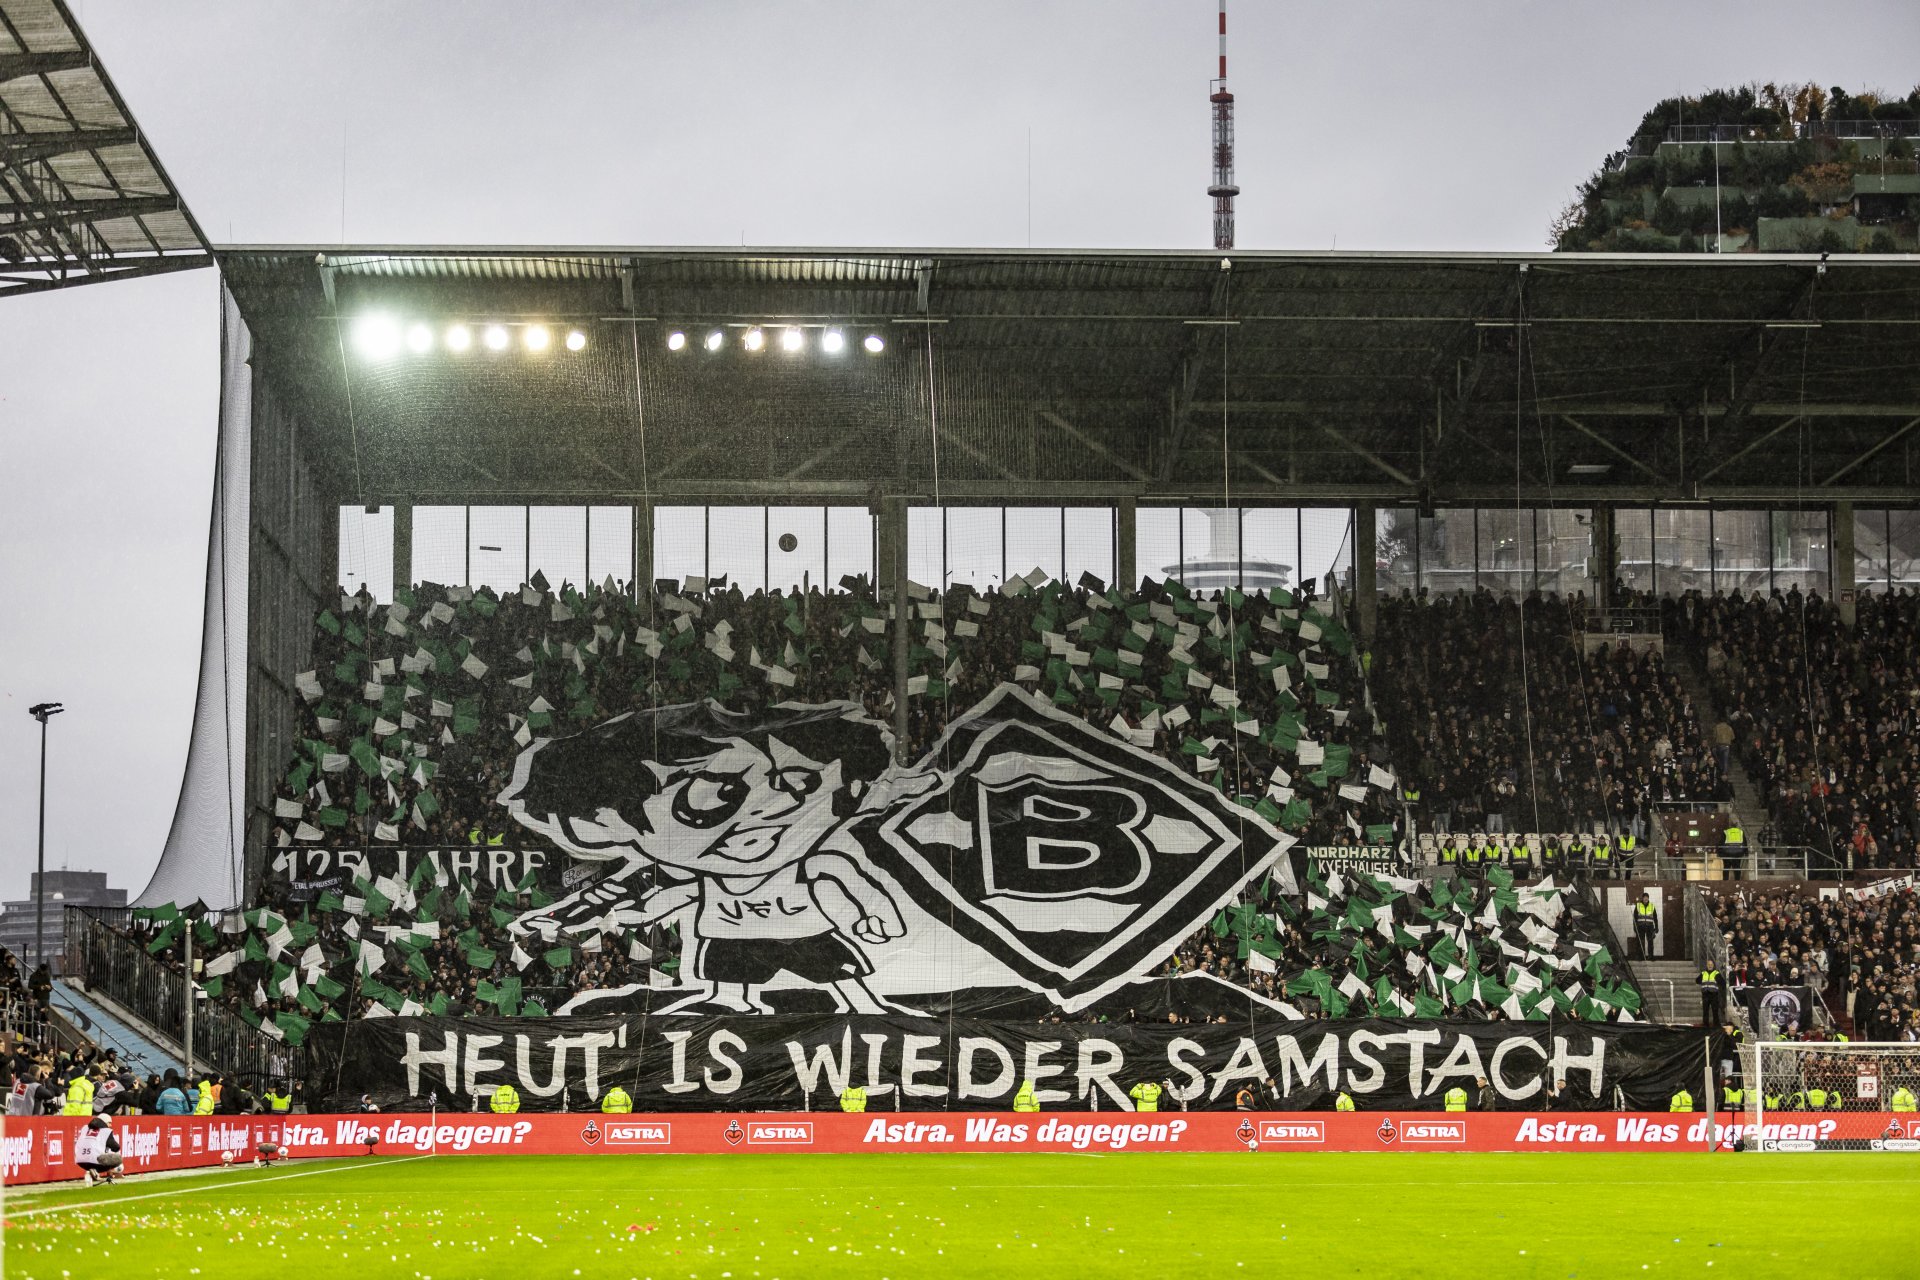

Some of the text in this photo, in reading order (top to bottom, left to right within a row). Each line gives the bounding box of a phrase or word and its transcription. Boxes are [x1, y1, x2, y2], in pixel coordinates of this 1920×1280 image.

[1306, 847, 1391, 859] NORDHARZ
[400, 1024, 1606, 1113] HEUT' IS WIEDER SAMSTACH
[1862, 1082, 1874, 1092] F3
[336, 1120, 379, 1145] Was
[385, 1120, 532, 1150] dagegen?
[610, 1128, 664, 1139] ASTRA
[753, 1127, 807, 1139] ASTRA
[863, 1118, 1187, 1149] Astra. Was dagegen?
[1265, 1126, 1318, 1137] ASTRA
[1406, 1126, 1459, 1137] ASTRA
[1515, 1118, 1606, 1142] Astra.
[1616, 1118, 1680, 1142] Was
[1781, 1141, 1812, 1149] congstar
[1887, 1141, 1918, 1149] congstar
